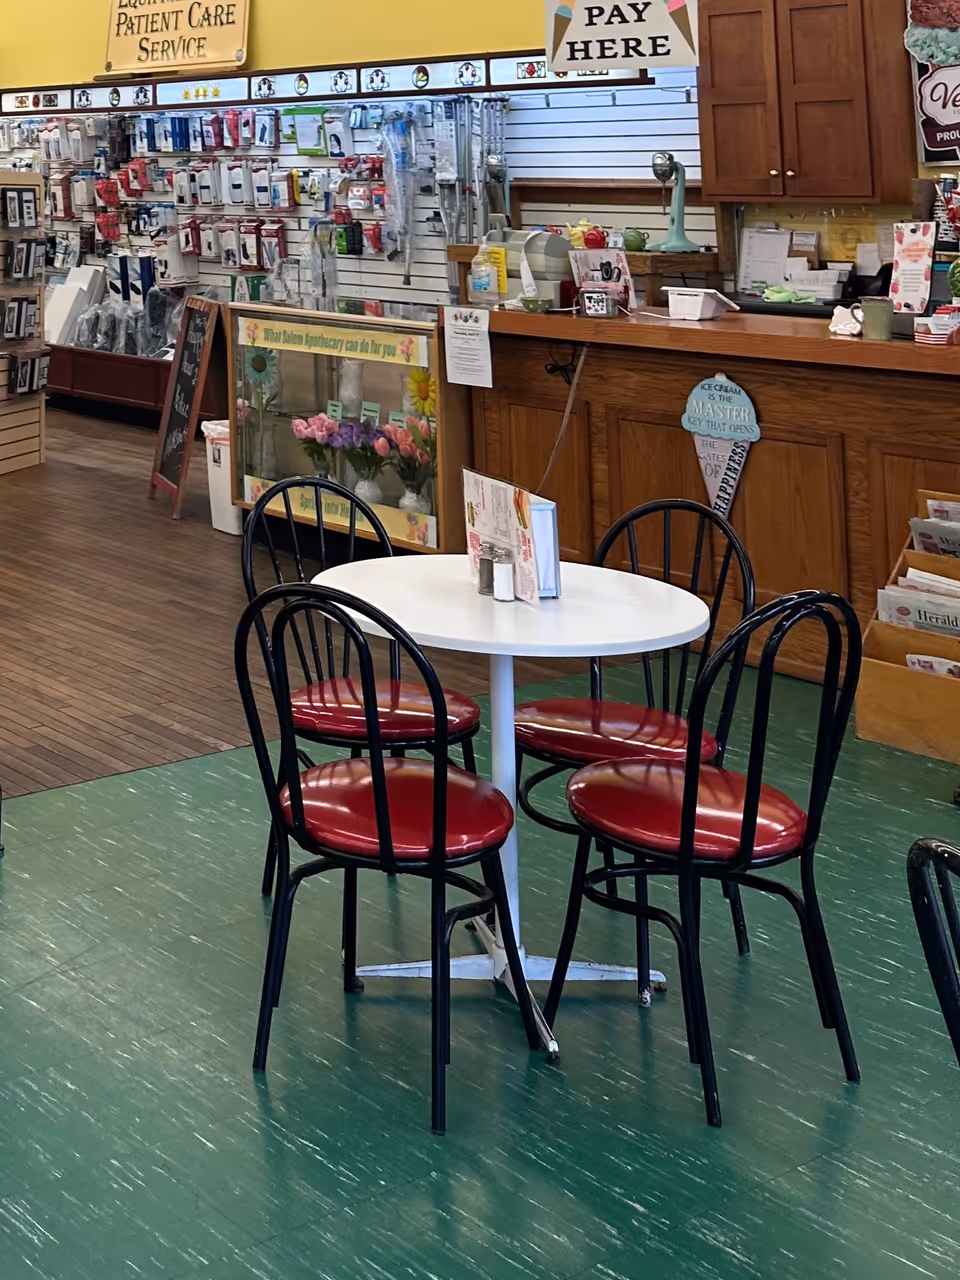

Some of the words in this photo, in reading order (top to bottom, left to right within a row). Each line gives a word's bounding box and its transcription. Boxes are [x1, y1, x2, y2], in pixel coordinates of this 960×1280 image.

[115, 10, 183, 38] PATIENT
[187, 1, 237, 28] CARE
[584, 1, 652, 27] PAY
[137, 35, 207, 62] SERVICE
[566, 35, 671, 61] HERE
[585, 294, 605, 307] Tips
[262, 327, 282, 343] What
[304, 332, 345, 353] Apothecary
[344, 339, 358, 352] can
[359, 338, 370, 354] do
[370, 339, 382, 355] for
[382, 344, 397, 359] you
[700, 383, 713, 391] ICE
[713, 383, 742, 396] CREAM
[718, 394, 733, 403] THE
[692, 399, 750, 422] MASTER
[687, 414, 702, 426] KEY
[706, 420, 727, 432] THAT
[729, 423, 755, 434] OPENS
[701, 439, 718, 449] THE
[704, 463, 722, 479] OF
[713, 441, 747, 516] HAPPINESS
[324, 500, 339, 515] into
[917, 609, 960, 628] Herald
